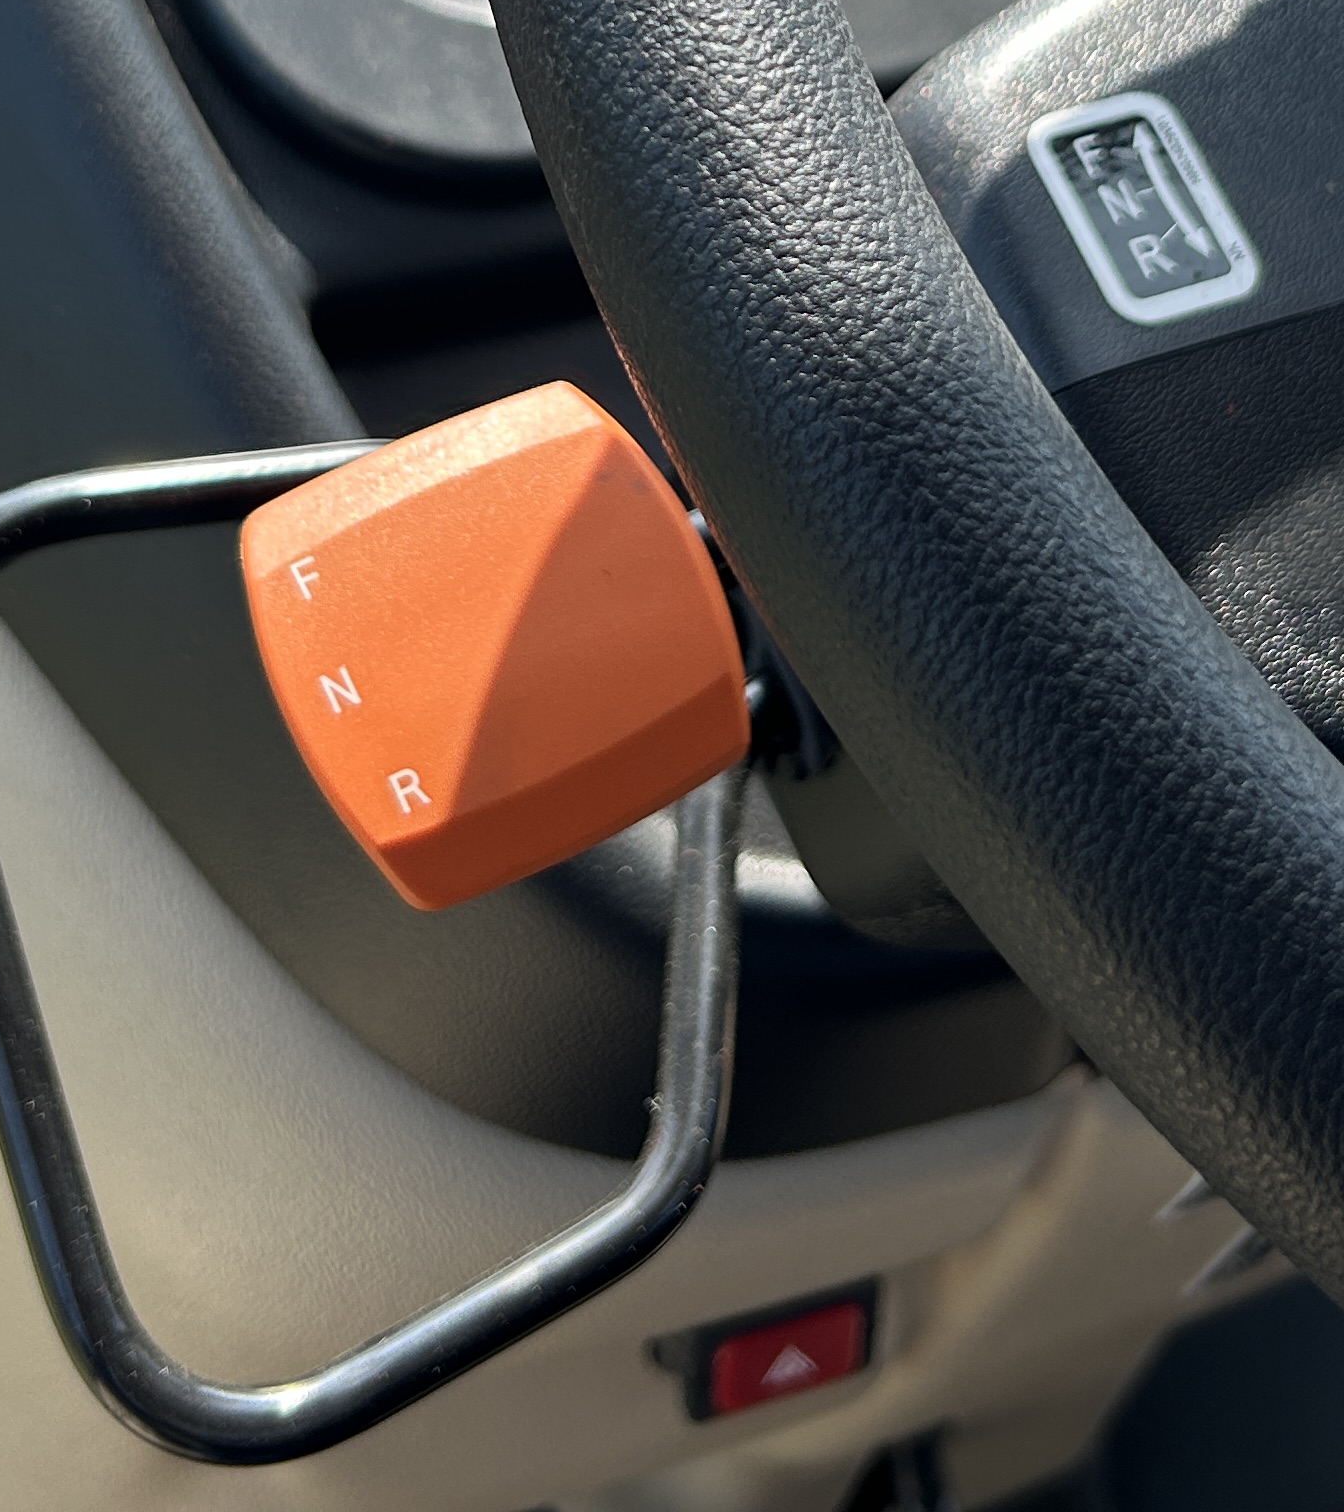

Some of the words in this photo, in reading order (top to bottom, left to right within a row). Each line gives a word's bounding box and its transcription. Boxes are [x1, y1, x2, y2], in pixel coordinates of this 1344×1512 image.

[1073, 133, 1108, 180] F
[1098, 178, 1145, 225] N
[1129, 234, 1179, 280] R
[289, 555, 320, 601] F
[318, 665, 362, 714] N
[387, 767, 432, 815] R
